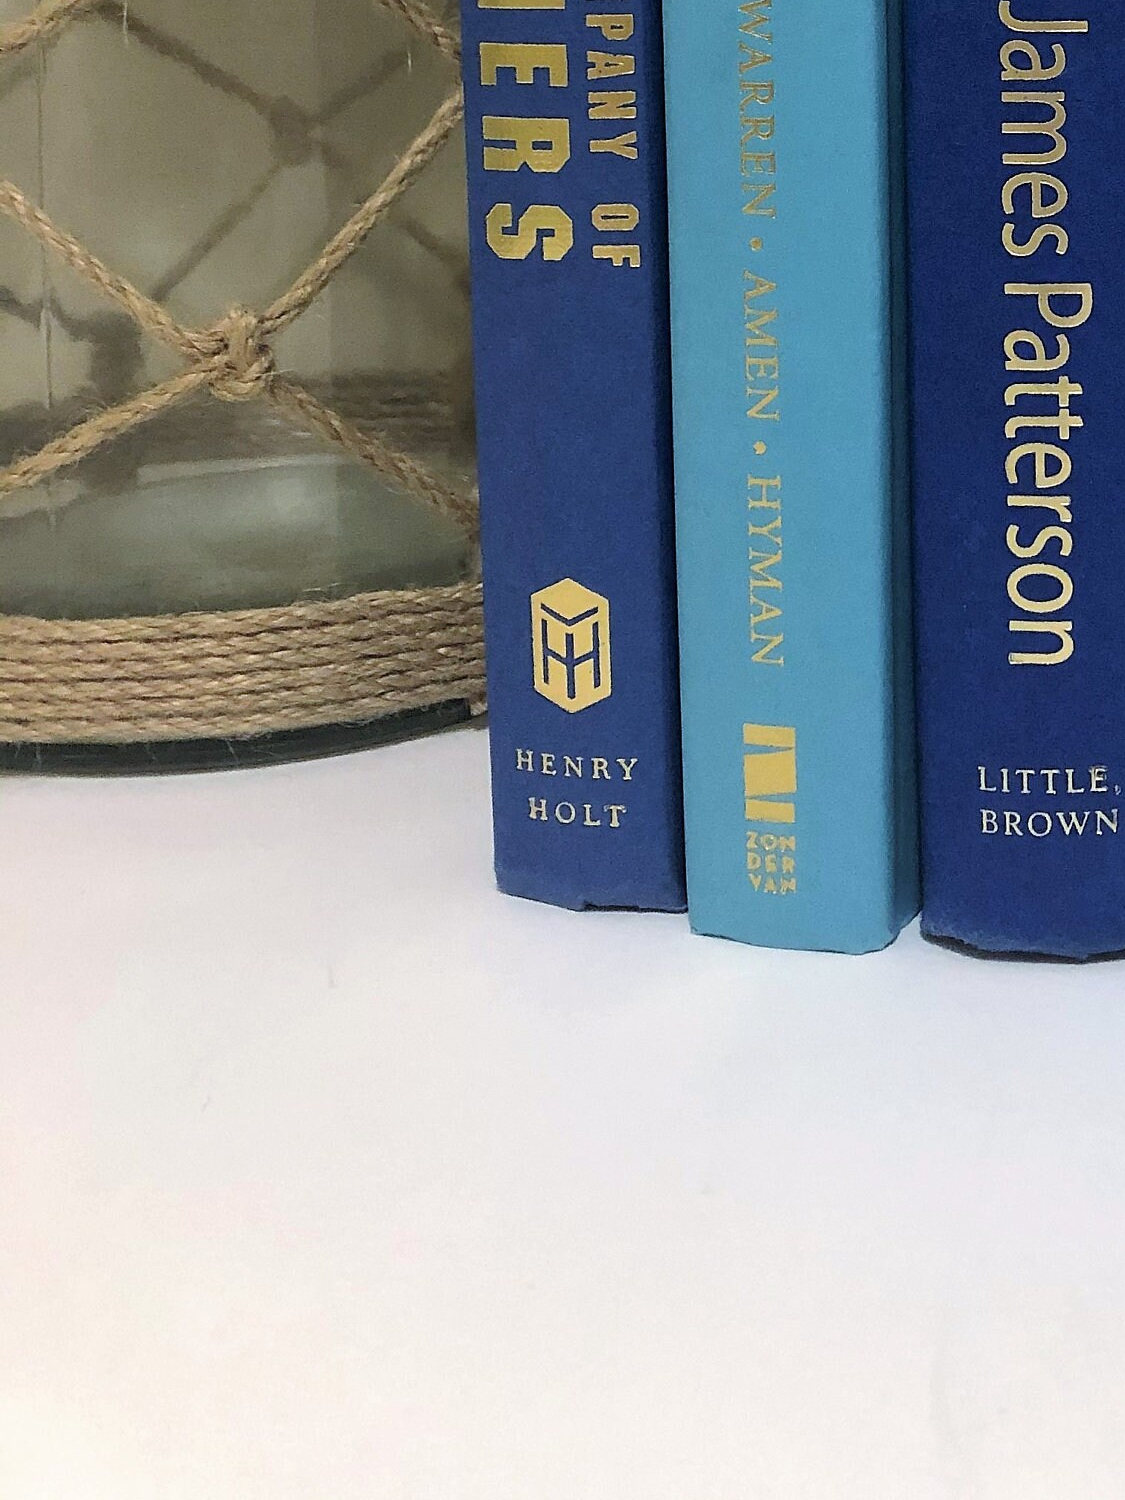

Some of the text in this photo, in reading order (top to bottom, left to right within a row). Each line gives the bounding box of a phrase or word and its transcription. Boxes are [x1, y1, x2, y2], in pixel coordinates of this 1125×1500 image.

[591, 203, 641, 268] OF
[743, 270, 780, 420] AMEN
[997, 0, 1094, 666] James Patterson
[746, 475, 784, 666] HYMAN
[515, 748, 638, 782] HENRY
[528, 796, 626, 828] HOLT
[978, 807, 1121, 837] BROWN
